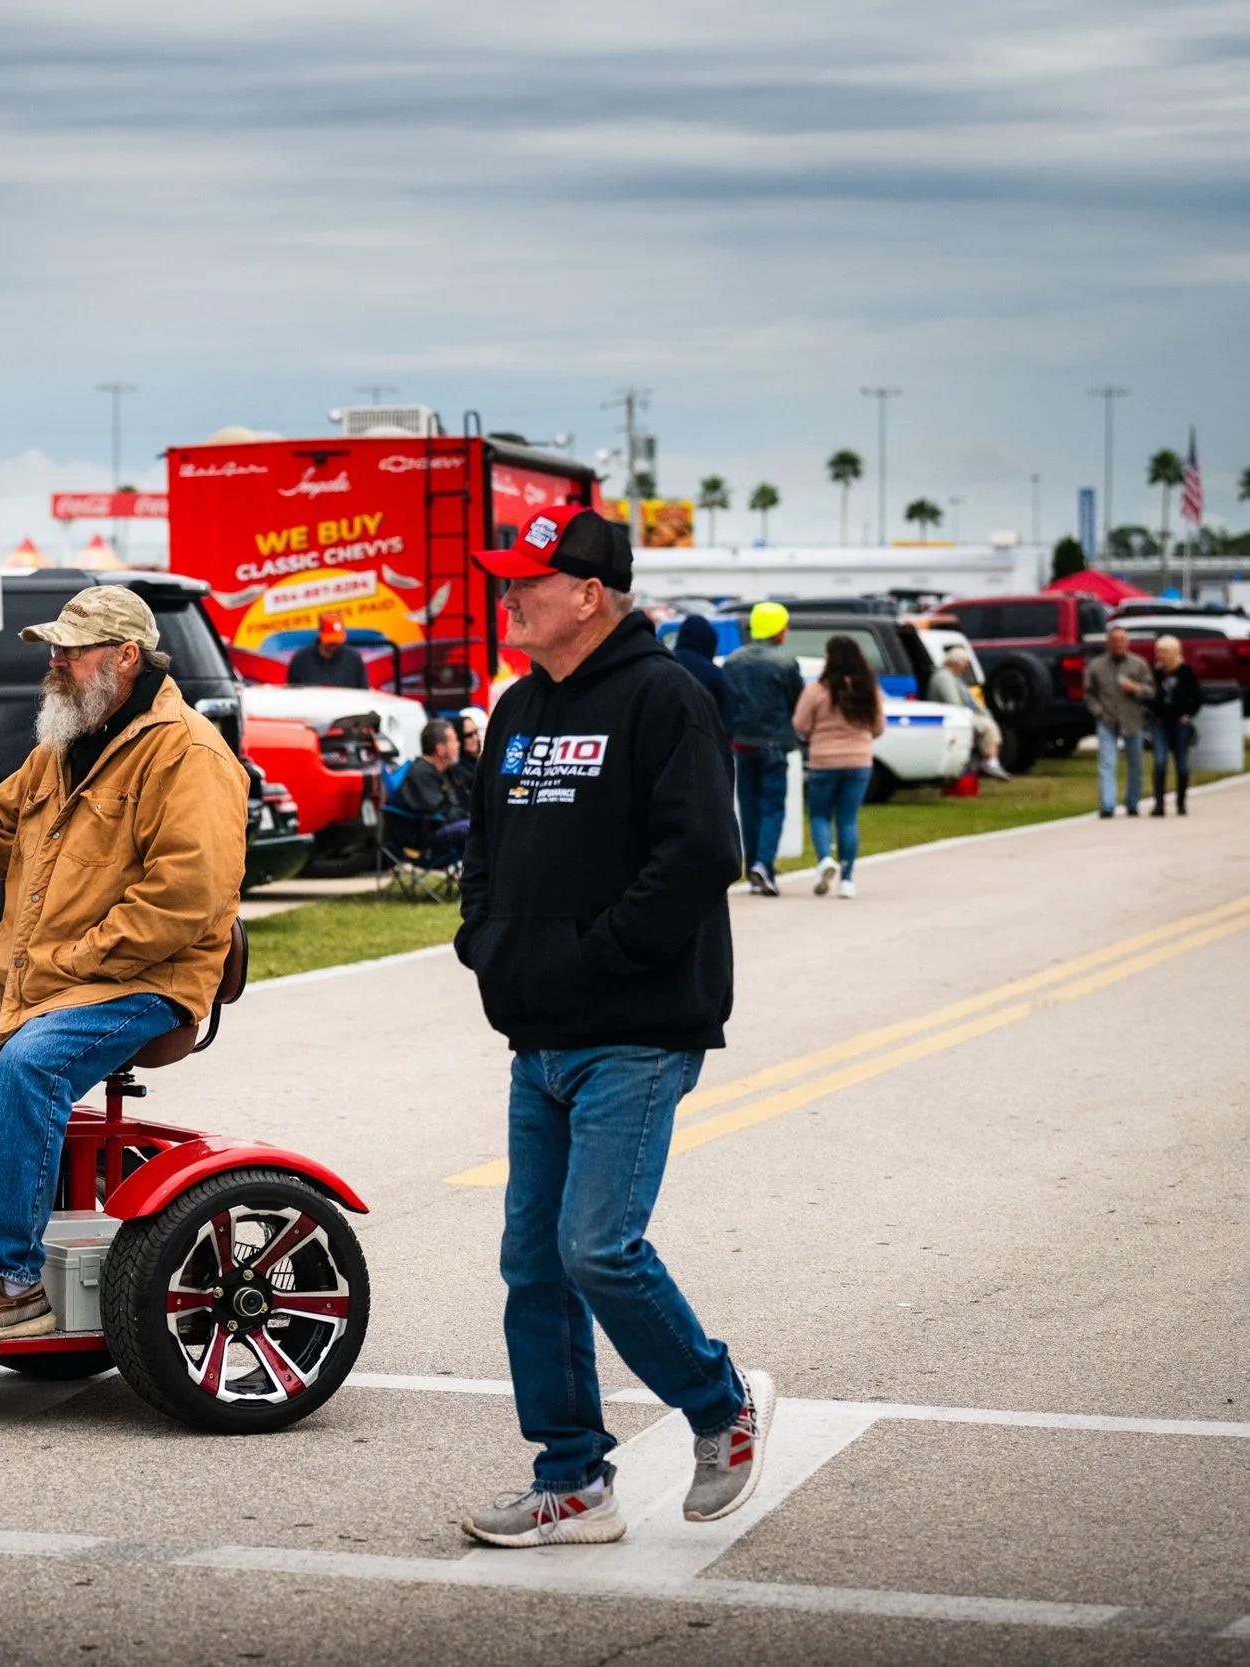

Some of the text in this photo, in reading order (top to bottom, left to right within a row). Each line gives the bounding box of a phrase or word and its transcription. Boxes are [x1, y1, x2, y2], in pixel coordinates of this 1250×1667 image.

[255, 512, 383, 557] WE BUY
[236, 536, 404, 582] CLASSIC CHEVYS
